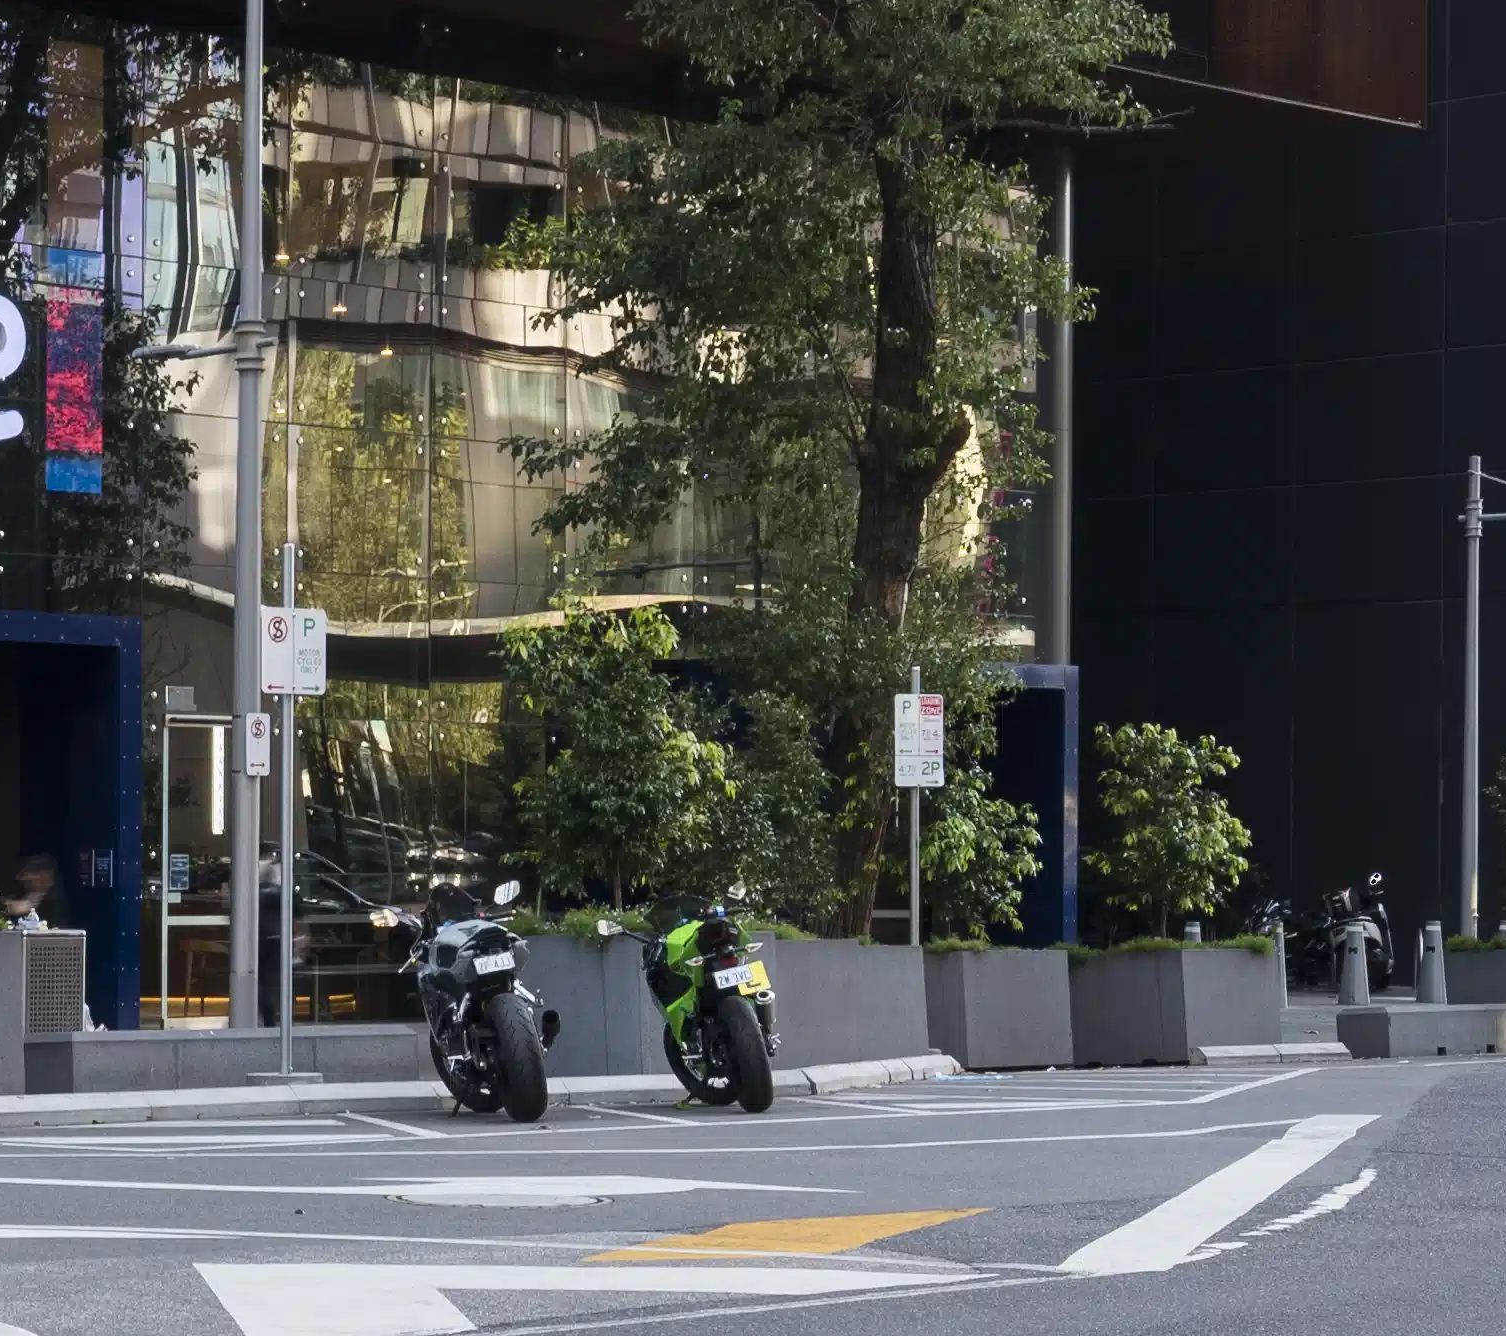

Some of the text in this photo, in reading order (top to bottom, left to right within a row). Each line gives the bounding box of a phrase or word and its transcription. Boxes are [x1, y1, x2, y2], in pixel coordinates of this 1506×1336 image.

[303, 617, 316, 637] P
[298, 648, 320, 657] MOTOR
[300, 665, 319, 673] ONLY
[921, 761, 941, 776] 2P
